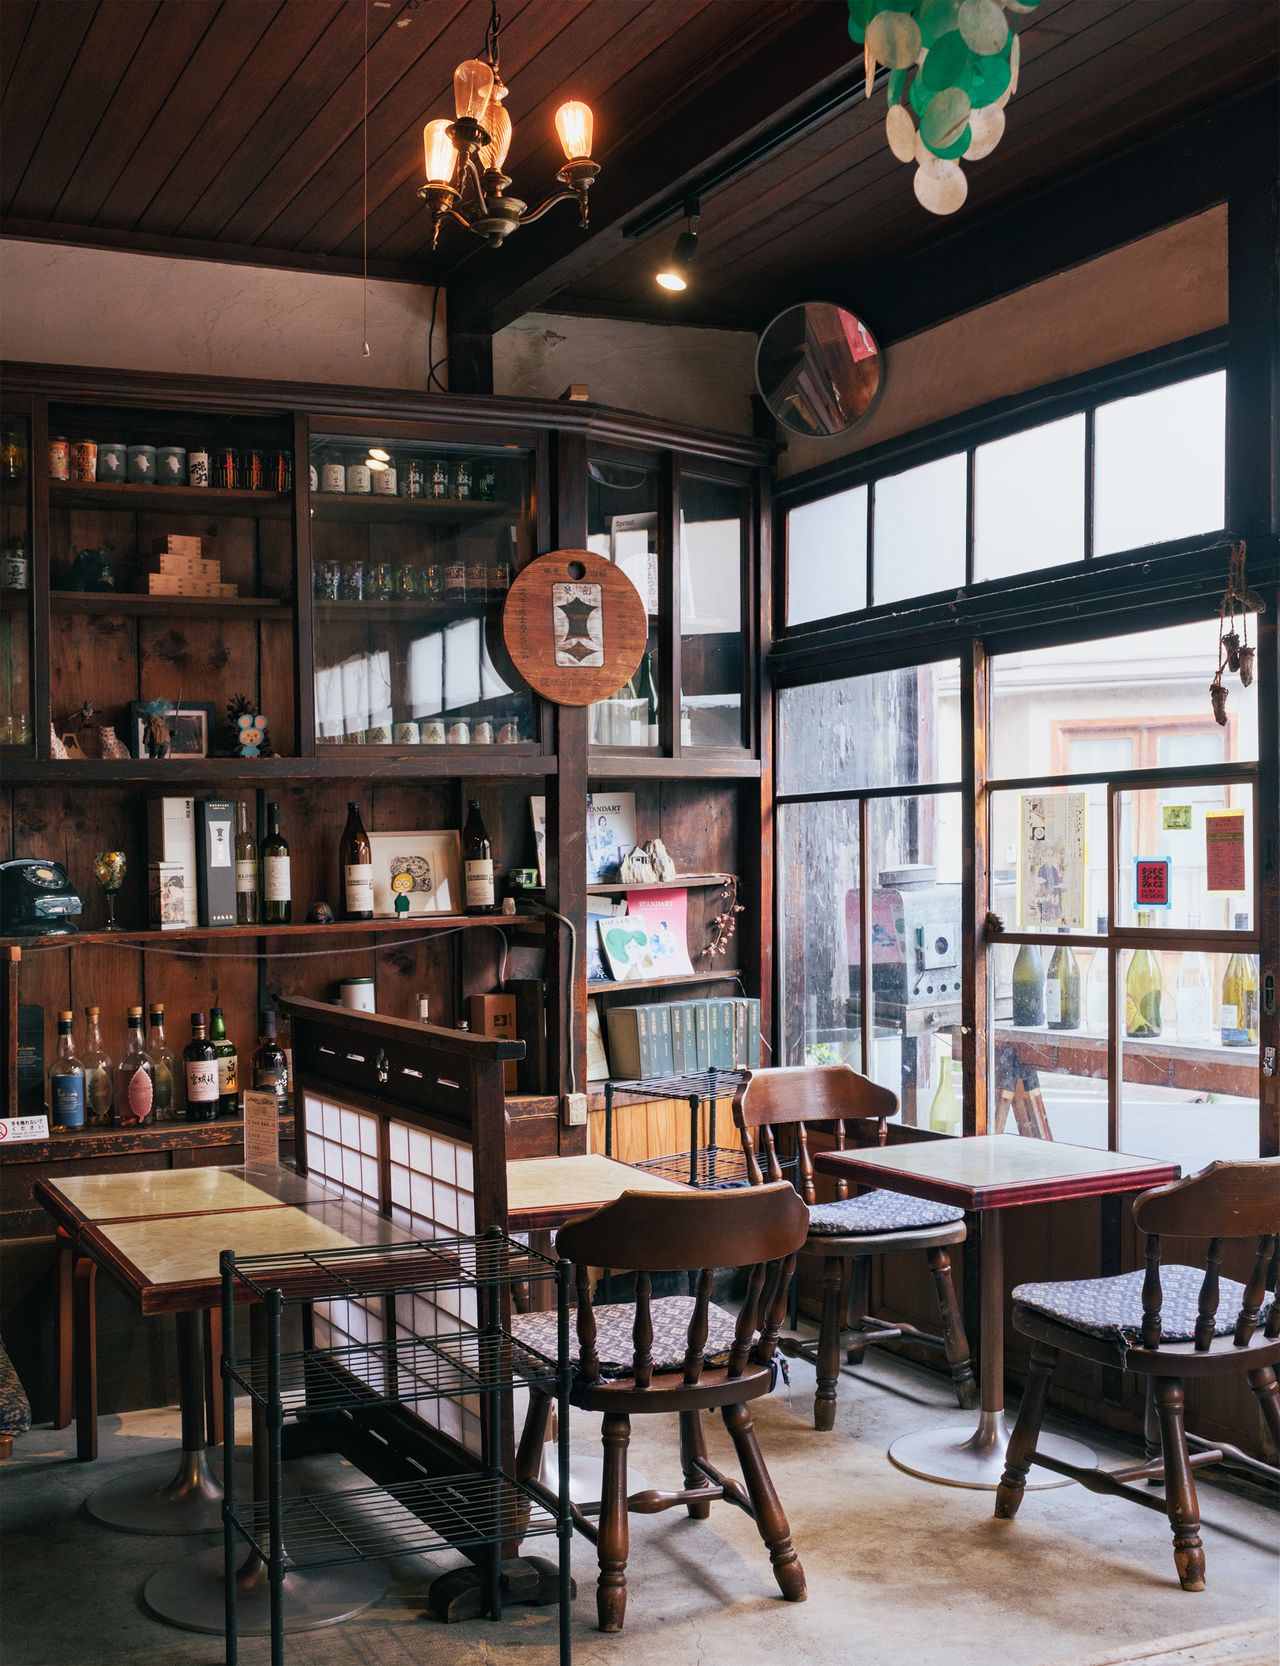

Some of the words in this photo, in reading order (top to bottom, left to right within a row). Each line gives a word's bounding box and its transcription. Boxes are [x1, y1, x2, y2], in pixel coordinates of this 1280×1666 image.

[615, 520, 635, 528] Sprout
[639, 900, 673, 908] STANDART
[226, 1060, 237, 1086] 白州
